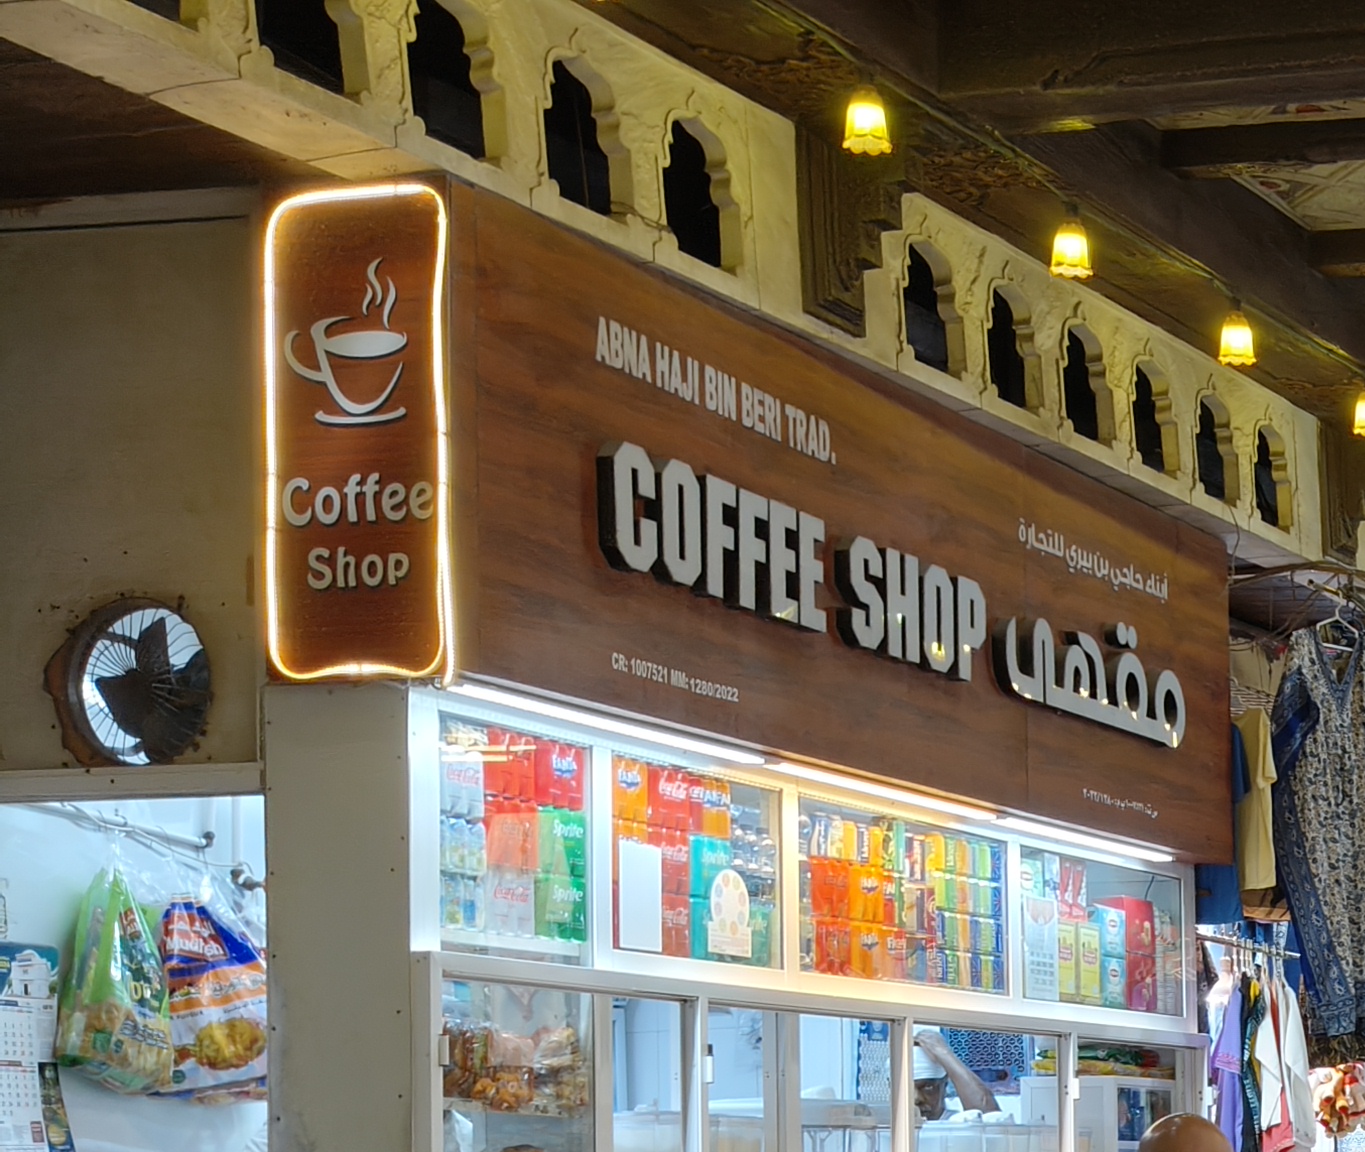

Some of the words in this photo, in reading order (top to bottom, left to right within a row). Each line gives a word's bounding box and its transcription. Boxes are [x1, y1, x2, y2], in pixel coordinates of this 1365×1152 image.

[595, 316, 652, 383] ABNA
[655, 341, 700, 405] HAJI
[704, 364, 737, 421] BIN
[741, 382, 782, 442] BERI
[784, 403, 836, 465] TRAD.
[283, 472, 434, 526] Coffee
[1018, 517, 1064, 557] للتجارة
[306, 546, 410, 591] Shop
[606, 441, 827, 633] COFFEE
[846, 535, 987, 682] SHOP
[1094, 551, 1109, 582] بن
[1110, 564, 1144, 591] حاجي
[1145, 572, 1168, 604] أبناء
[611, 652, 628, 672] CR:
[630, 657, 668, 684] 1007521
[689, 678, 739, 702] 1280/2022
